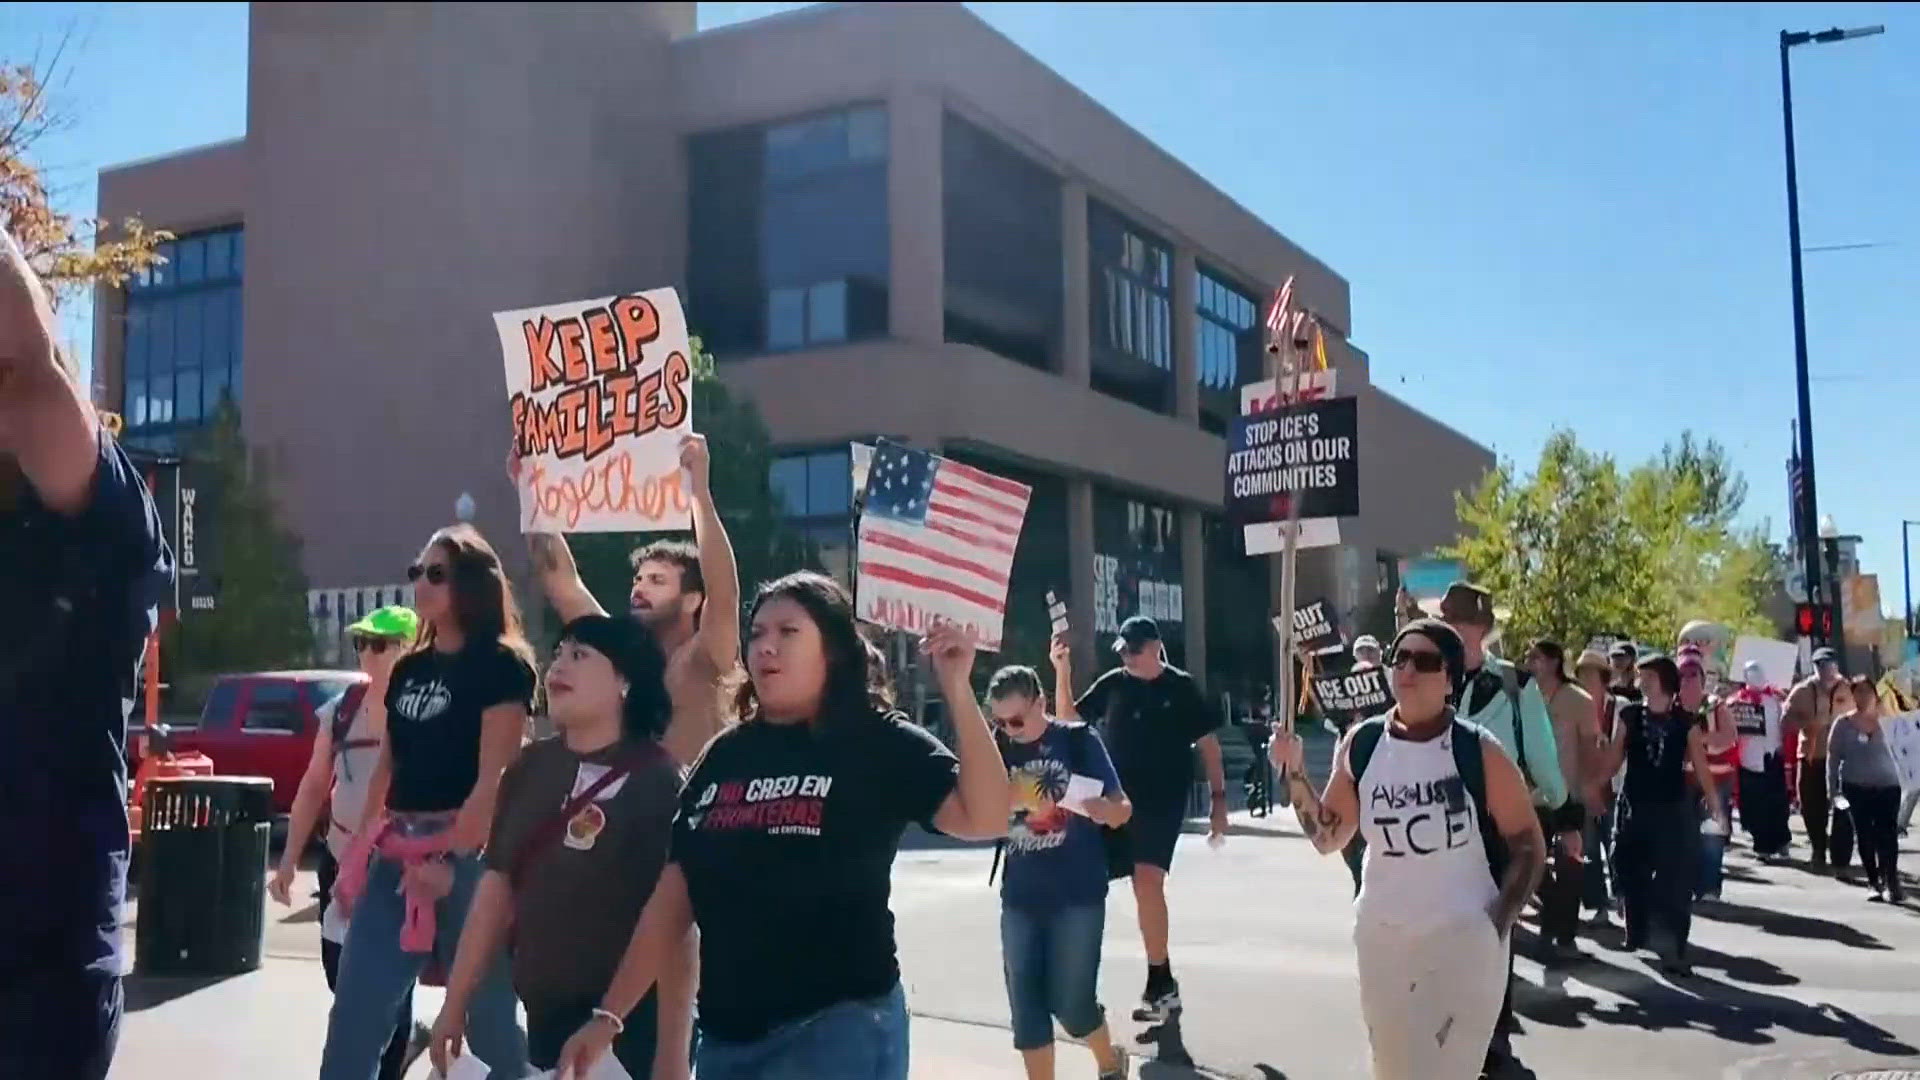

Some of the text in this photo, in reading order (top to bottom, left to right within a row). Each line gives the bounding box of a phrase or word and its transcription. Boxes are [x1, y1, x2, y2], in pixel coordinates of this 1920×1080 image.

[522, 295, 660, 392] KEEP
[511, 350, 689, 461] FAMILIES
[1245, 412, 1319, 447] STOP ICE'S
[1228, 436, 1350, 475] ATTACKS ON OUR
[528, 451, 690, 528] together
[1233, 464, 1337, 499] COMMUNITIES
[1293, 601, 1325, 630] OUT
[1315, 670, 1381, 699] ICE OUT
[745, 775, 798, 802] CREO
[798, 774, 832, 798] EN
